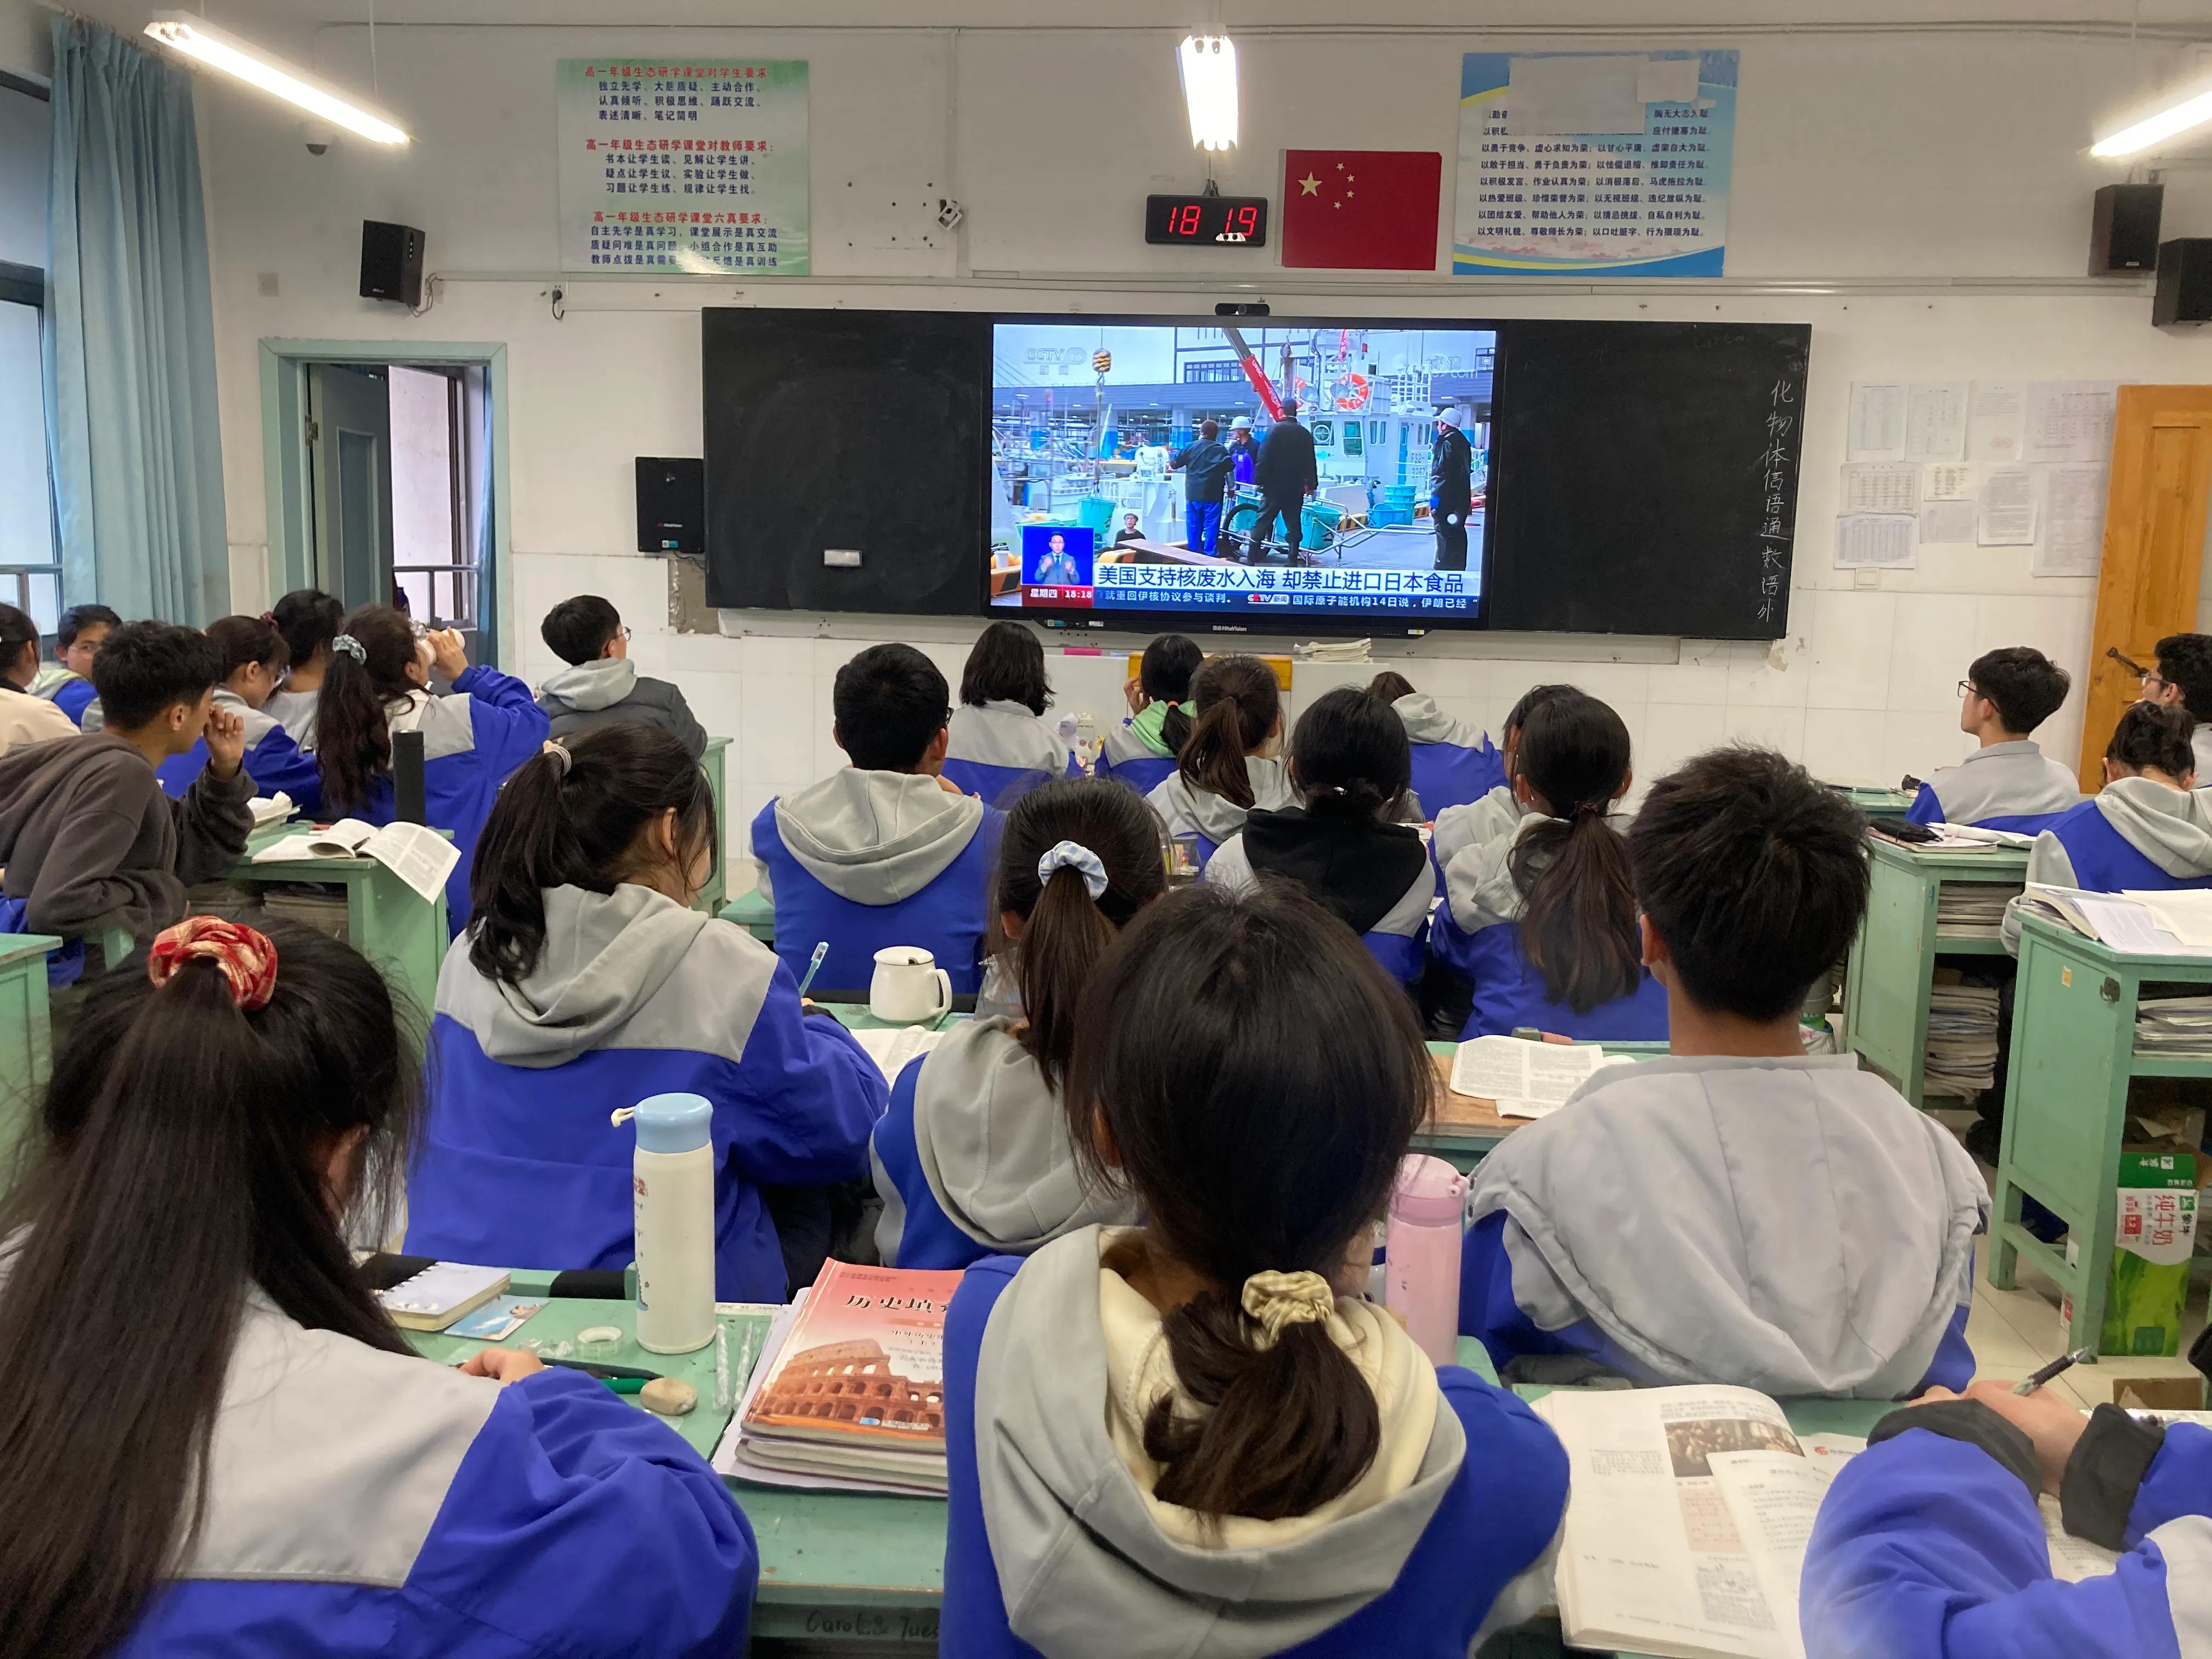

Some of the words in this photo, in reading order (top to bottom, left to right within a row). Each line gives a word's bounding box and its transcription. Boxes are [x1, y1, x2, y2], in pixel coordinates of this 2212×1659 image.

[1168, 205, 1201, 235] 18
[1225, 206, 1257, 236] 19
[1098, 565, 1276, 589] 美国支持核废水入海
[1282, 569, 1464, 593] 却禁止进口日本食品
[1030, 589, 1058, 599] 星期四
[1064, 589, 1092, 599] 18:18
[2152, 1195, 2176, 1245] 纯牛奶
